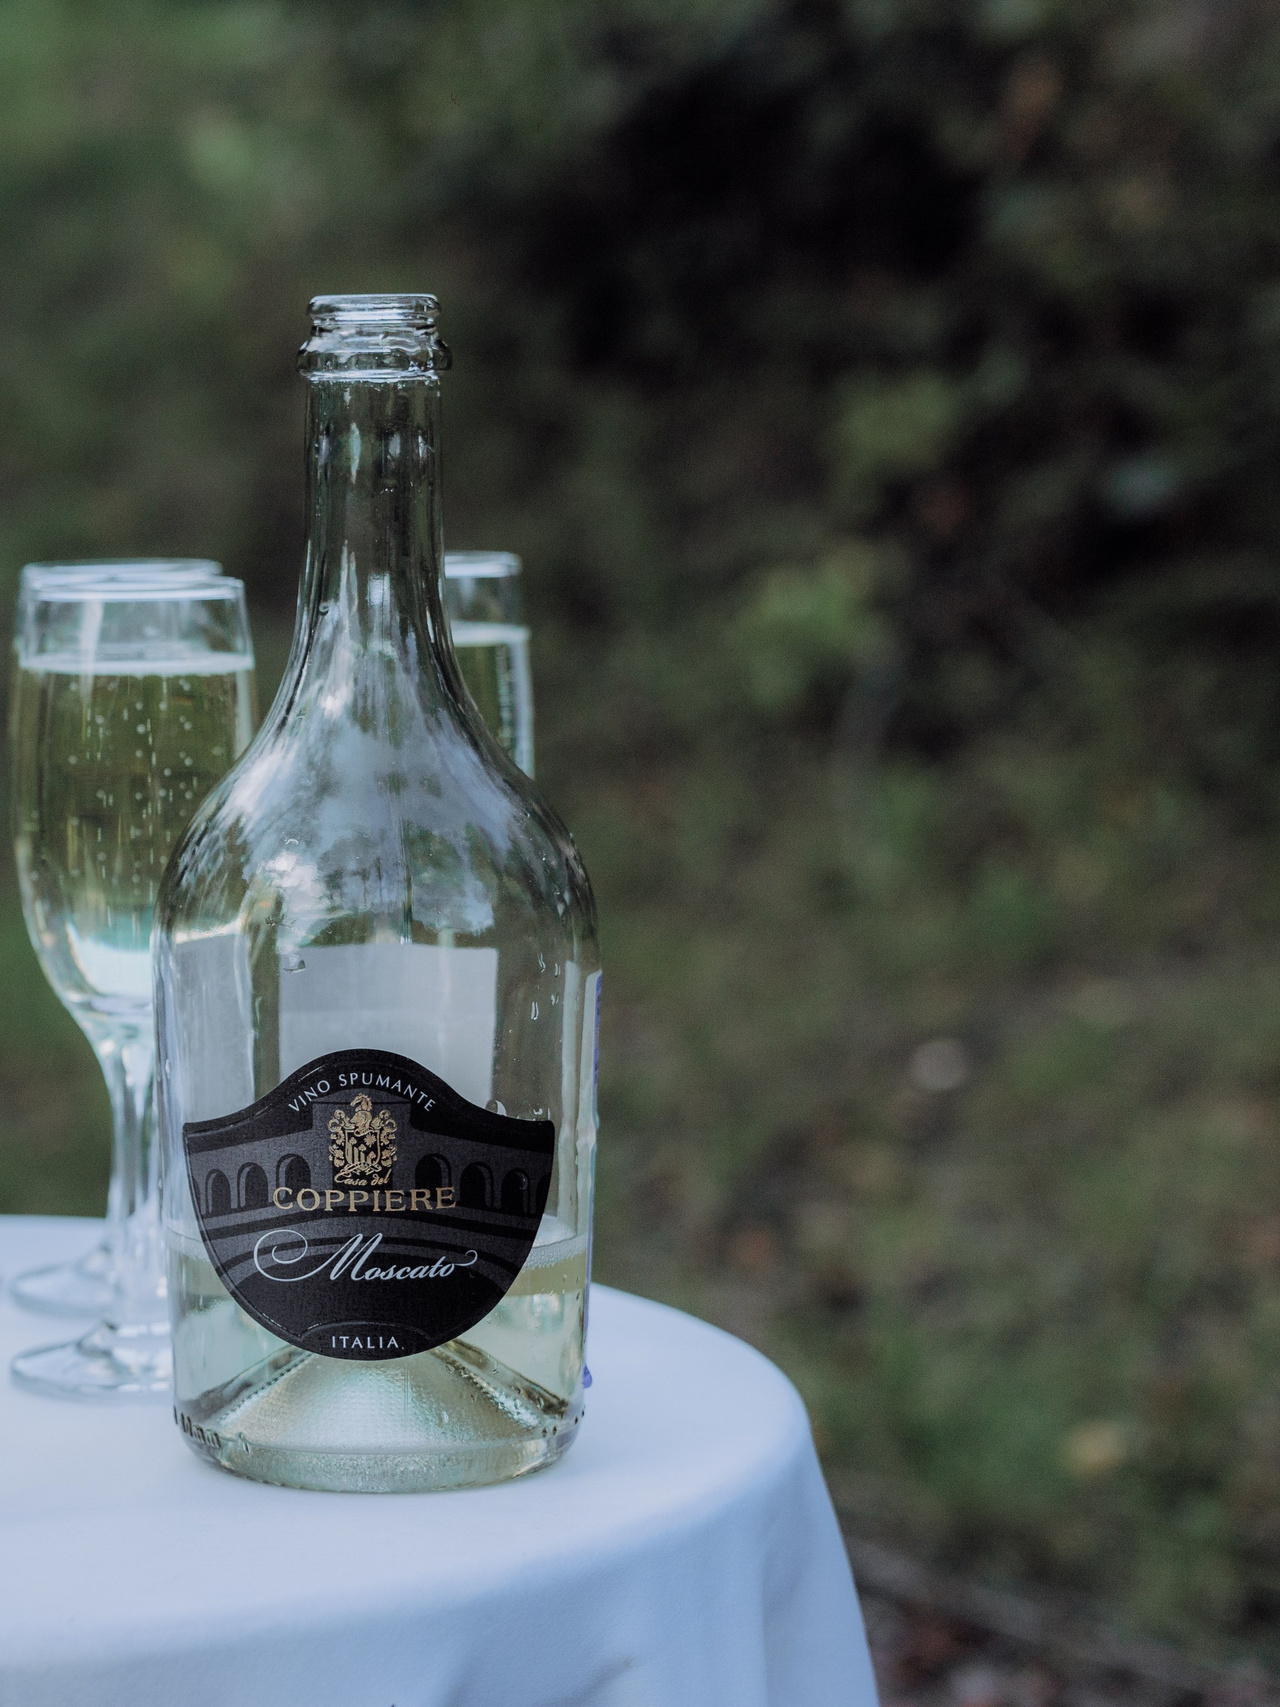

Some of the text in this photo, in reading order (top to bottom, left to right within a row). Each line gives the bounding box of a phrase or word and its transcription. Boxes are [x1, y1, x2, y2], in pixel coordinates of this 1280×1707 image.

[288, 1072, 436, 1112] VINO SPUMANTE
[334, 1169, 392, 1186] Casa del
[273, 1187, 457, 1212] COPPIERE
[253, 1229, 478, 1282] Moscato
[332, 1336, 399, 1349] ITALIA
